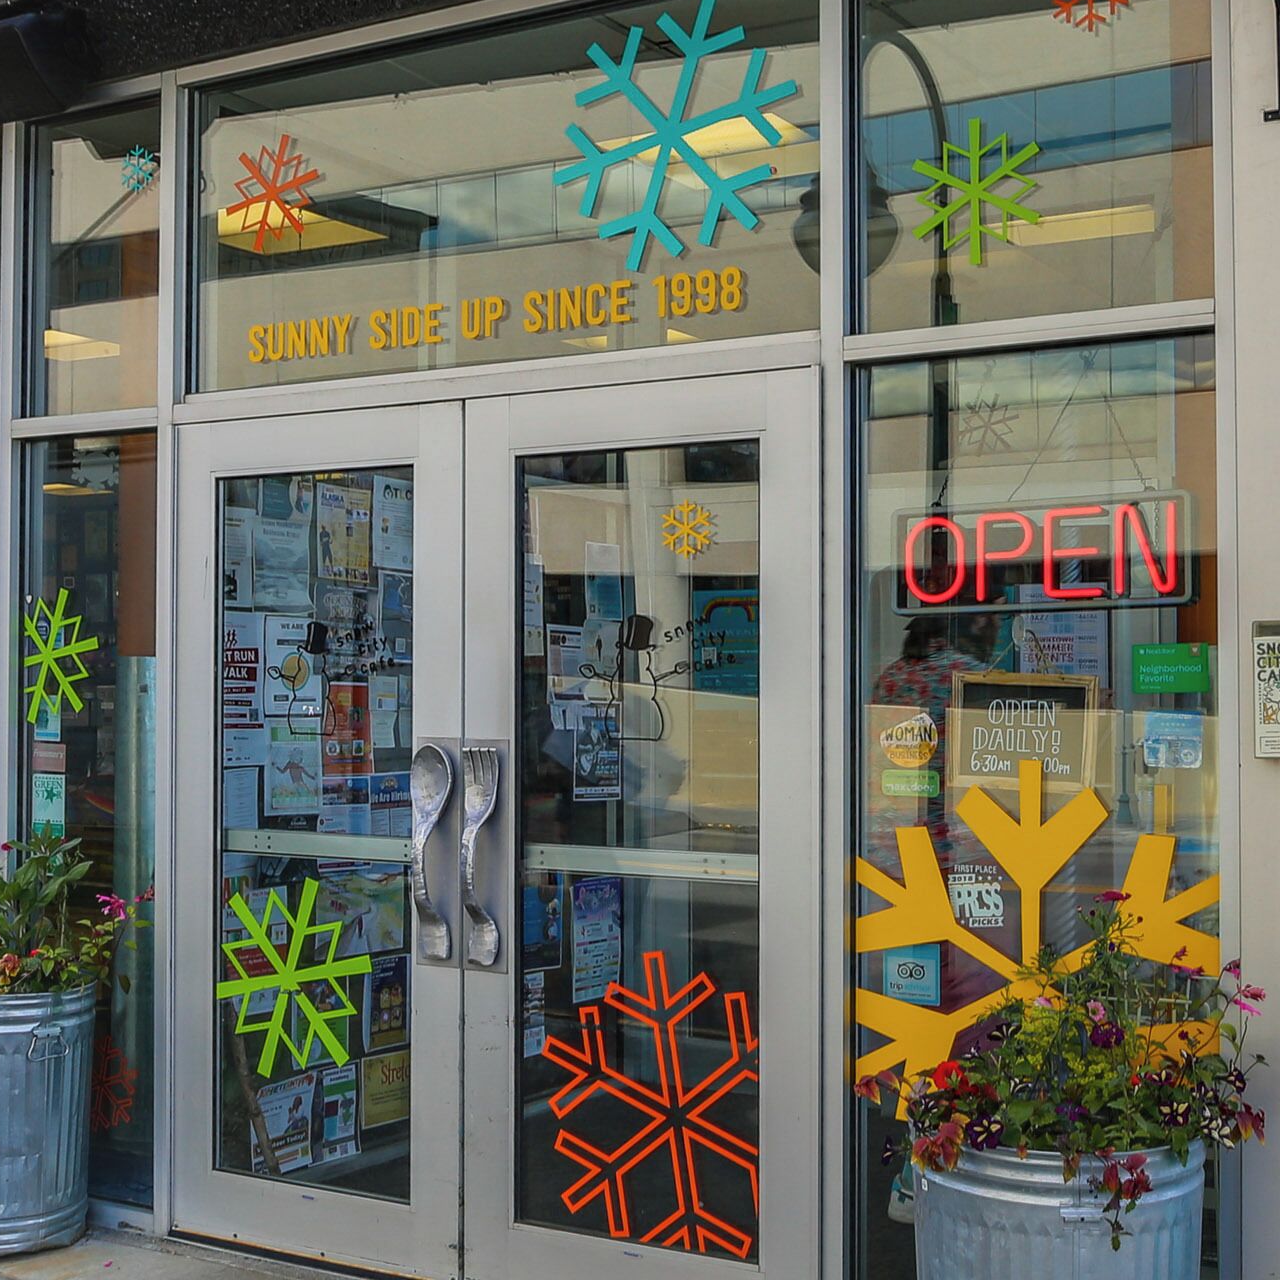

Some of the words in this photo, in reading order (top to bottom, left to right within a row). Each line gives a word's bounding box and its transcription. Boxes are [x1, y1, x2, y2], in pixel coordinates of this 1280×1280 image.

[248, 313, 352, 363] SUNNY
[369, 303, 444, 350] SIDE
[461, 295, 505, 340] UP
[522, 279, 632, 333] SINCE
[652, 265, 743, 319] 1998
[905, 500, 1177, 604] OPEN
[663, 616, 711, 643] snow
[358, 636, 388, 655] city
[691, 630, 726, 650] city
[235, 651, 255, 661] RUN
[1139, 663, 1202, 674] Neighborhood
[1139, 674, 1175, 683] Favorite
[988, 698, 1057, 727] OPEN
[884, 723, 933, 742] WOMAN
[972, 726, 1061, 754] DAILY!
[889, 751, 929, 761] BUSINESS
[34, 780, 63, 790] GREEN
[954, 864, 974, 873] FIRST
[974, 865, 998, 874] PLACE
[949, 882, 1004, 918] PRESS
[971, 918, 1000, 926] PICKS
